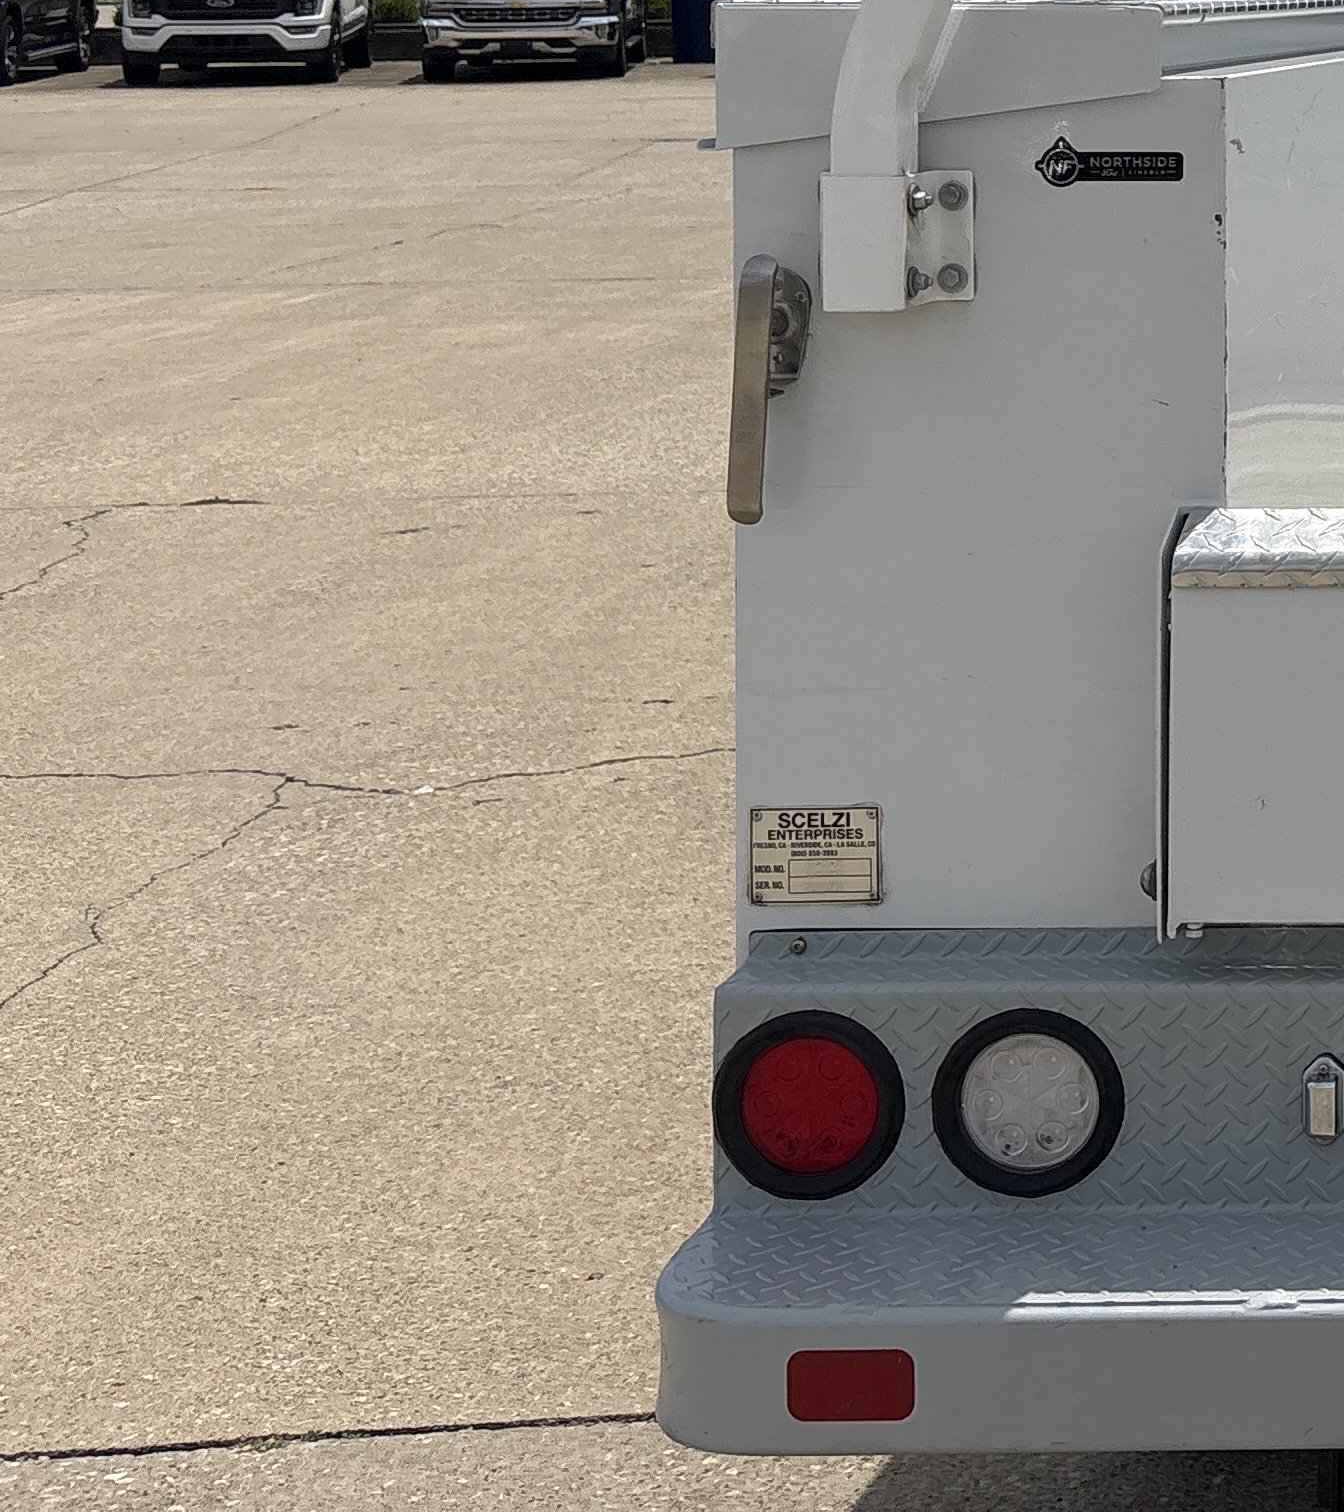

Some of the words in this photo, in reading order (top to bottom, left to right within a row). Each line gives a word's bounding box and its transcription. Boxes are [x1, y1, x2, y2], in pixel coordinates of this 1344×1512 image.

[1089, 156, 1177, 168] NORTHSIDE
[778, 812, 851, 828] SCELZI
[767, 828, 864, 840] ENTERPRISES
